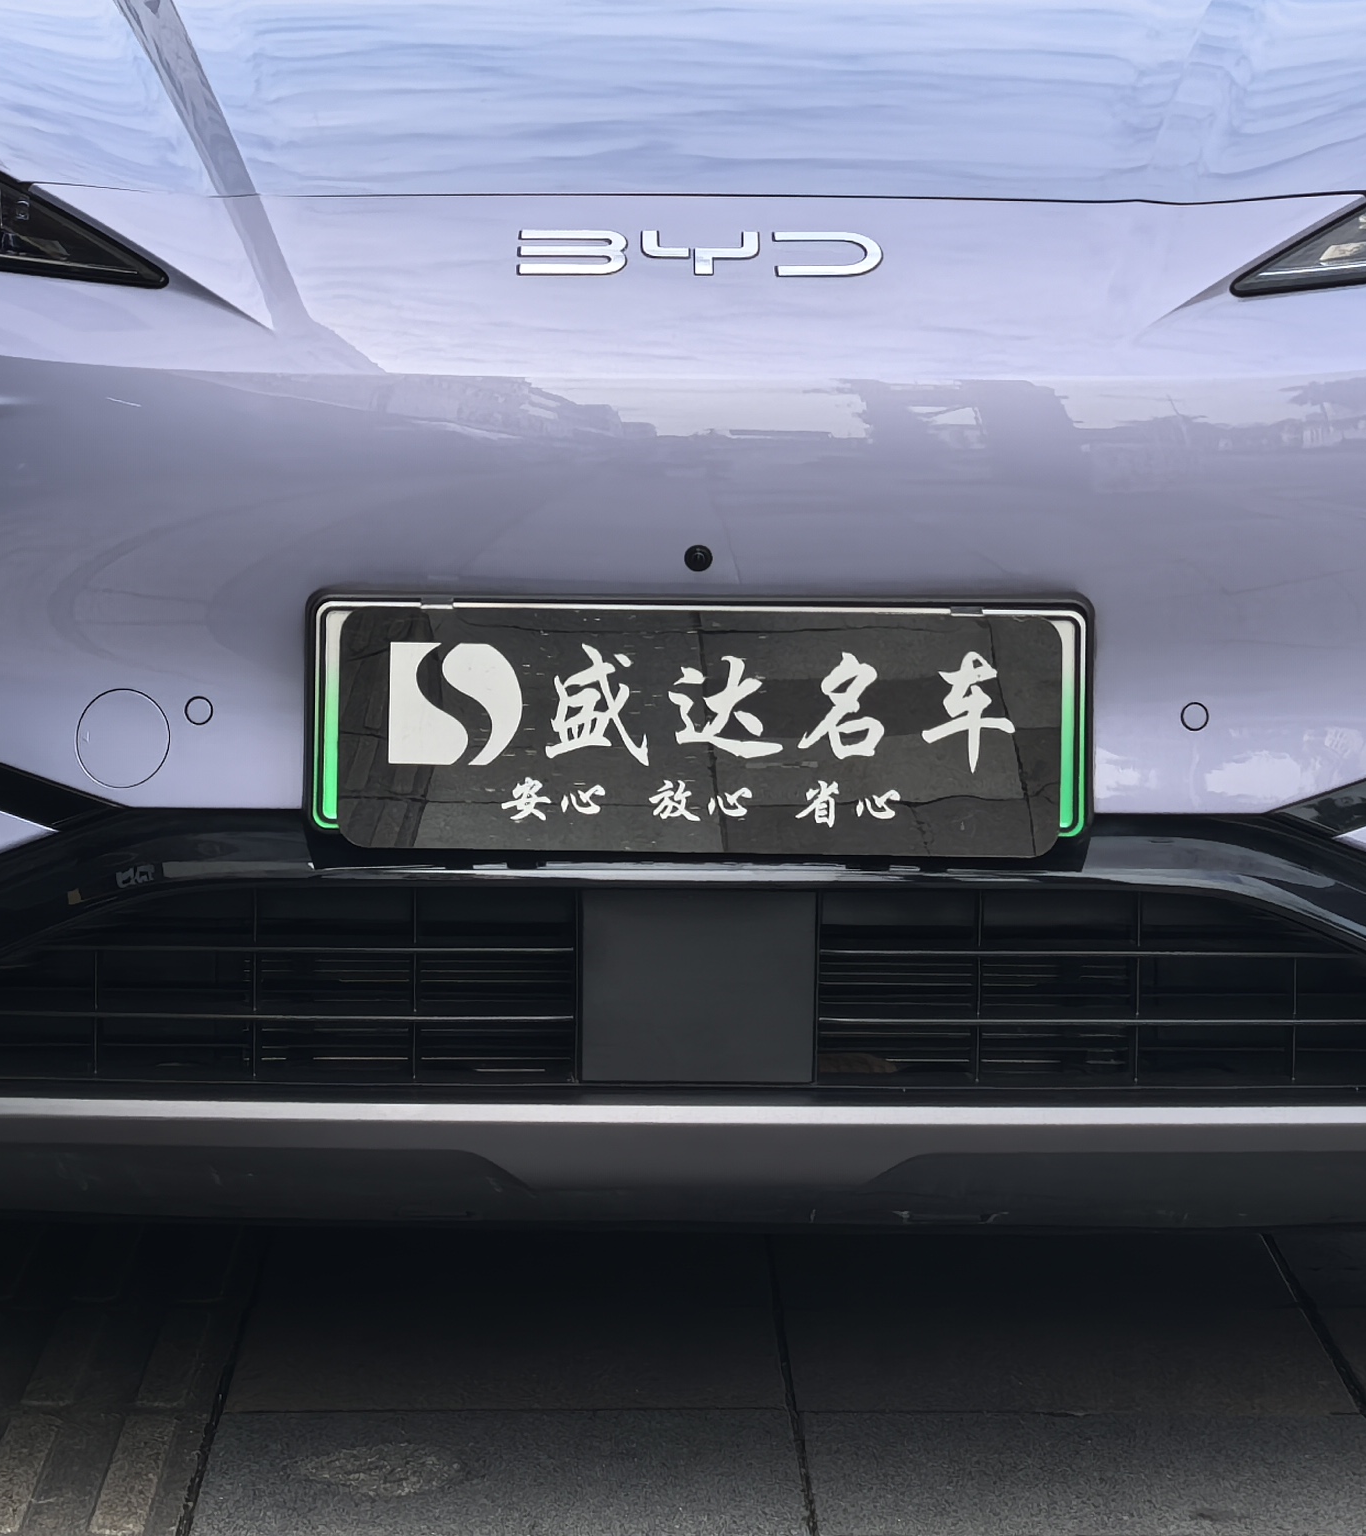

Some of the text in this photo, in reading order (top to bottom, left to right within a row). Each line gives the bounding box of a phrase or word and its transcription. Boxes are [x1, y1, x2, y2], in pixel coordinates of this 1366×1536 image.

[516, 229, 885, 277] BYD
[546, 644, 1015, 772] 盛达名车
[502, 777, 900, 827] 安心 放心 省心
